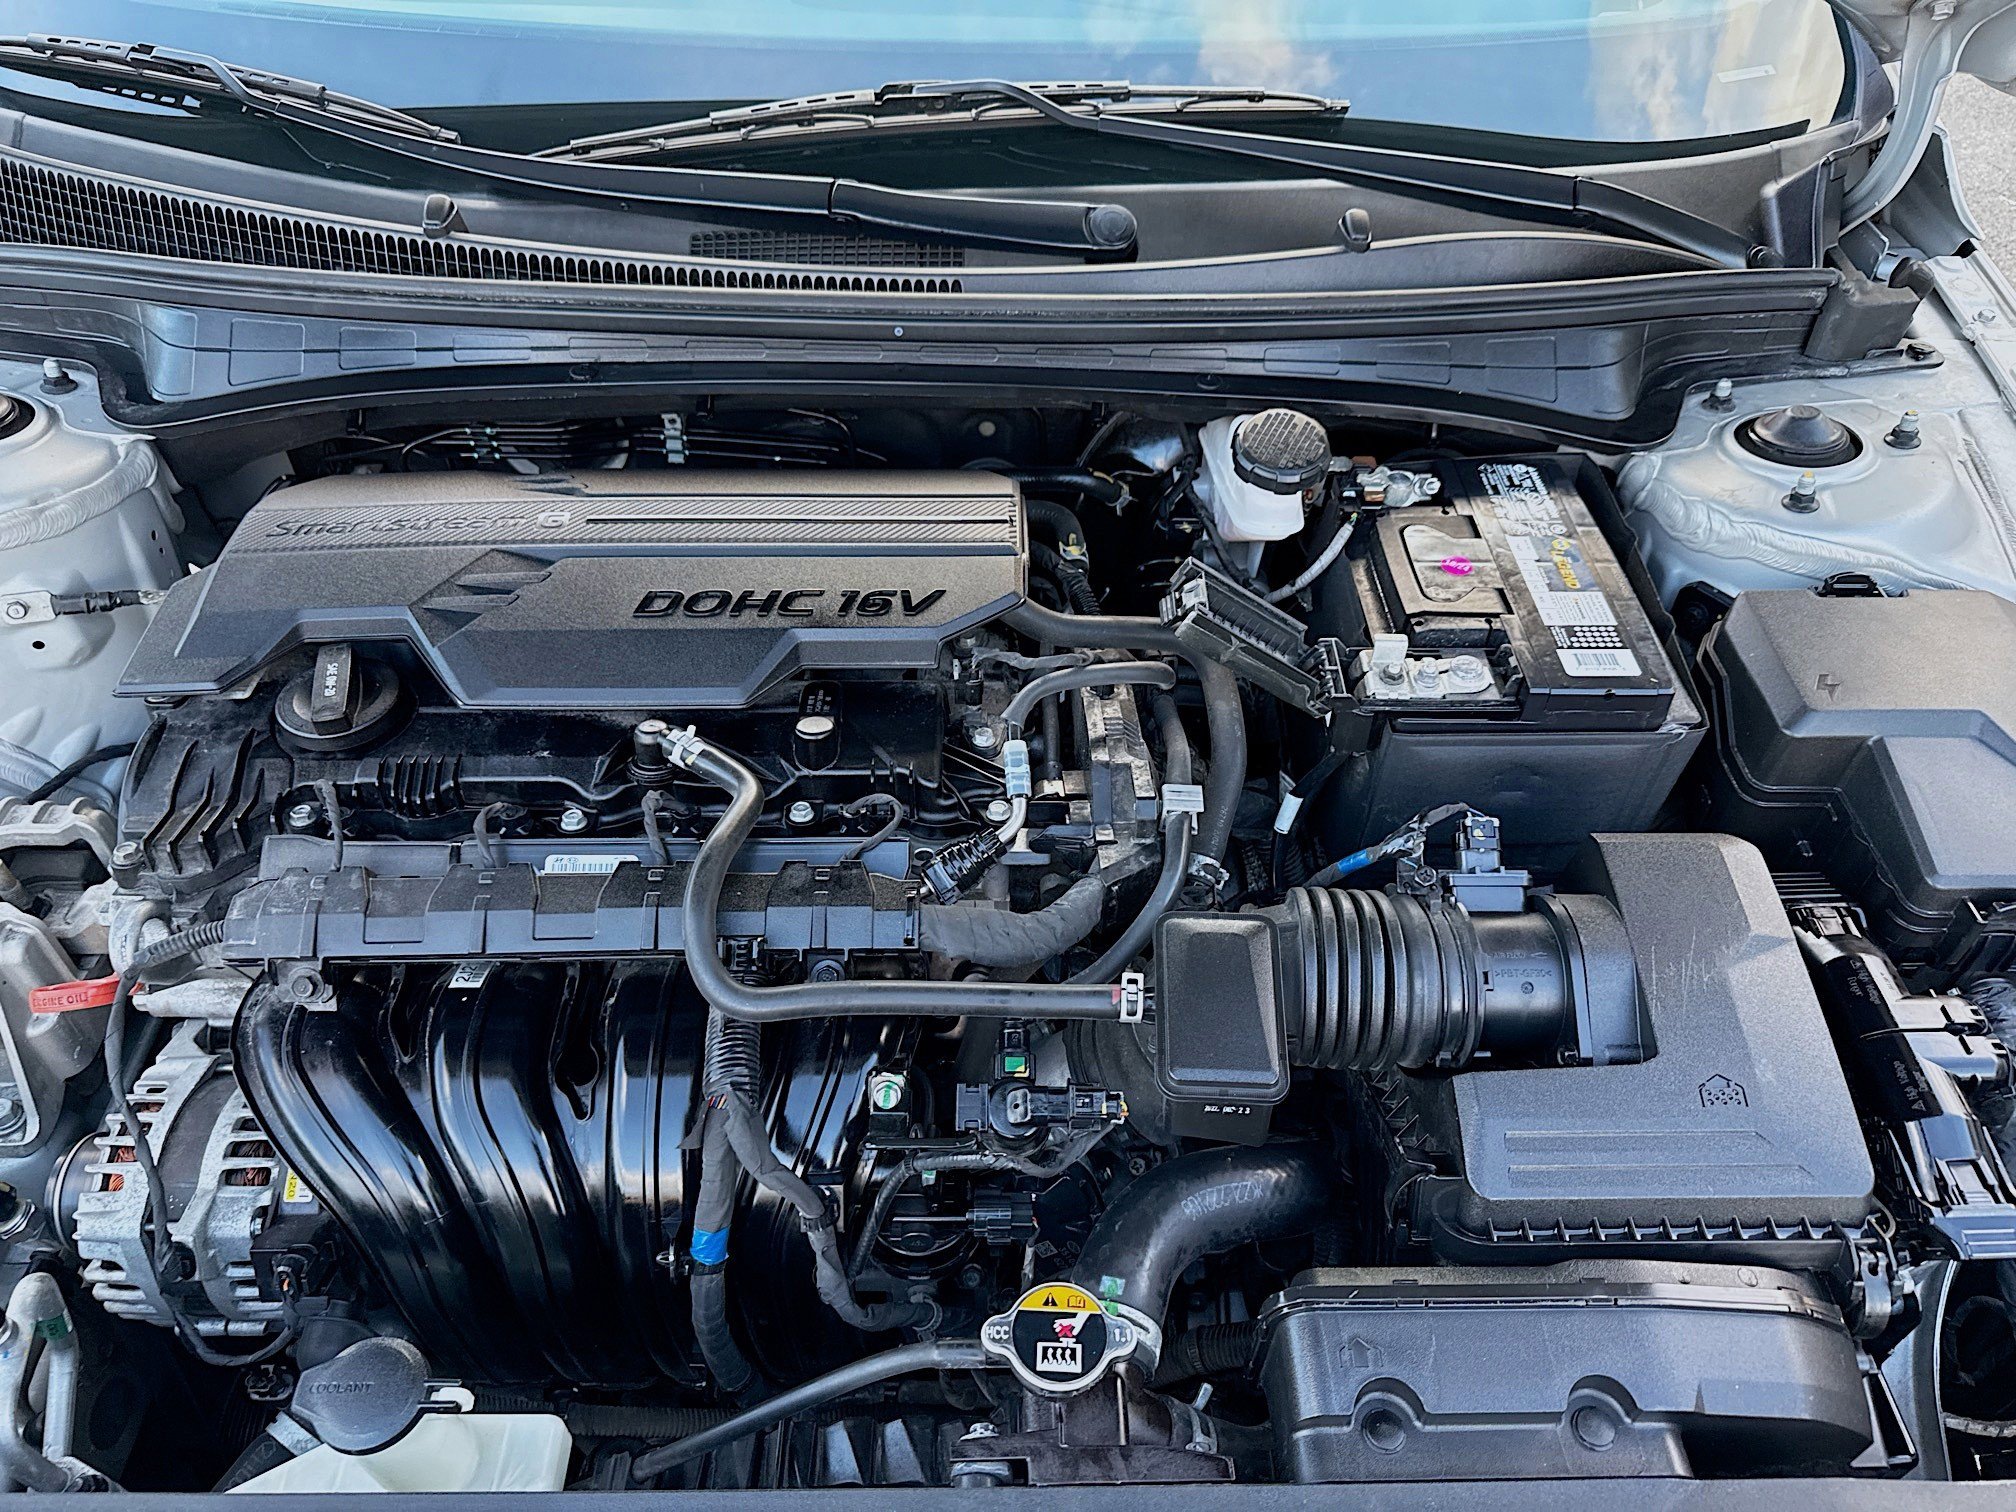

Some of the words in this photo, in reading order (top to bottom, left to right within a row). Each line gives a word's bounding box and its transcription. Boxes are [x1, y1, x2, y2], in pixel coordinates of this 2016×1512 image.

[265, 517, 526, 538] Smartstream
[538, 512, 570, 530] G
[632, 588, 826, 618] DOHC
[836, 588, 948, 618] 16V
[326, 662, 339, 676] SAE
[32, 996, 64, 1008] ENGINE
[66, 992, 88, 1005] OIL
[985, 1324, 1010, 1340] HCC
[1113, 1327, 1132, 1343] 1.1
[309, 1381, 375, 1395] COOLANT
